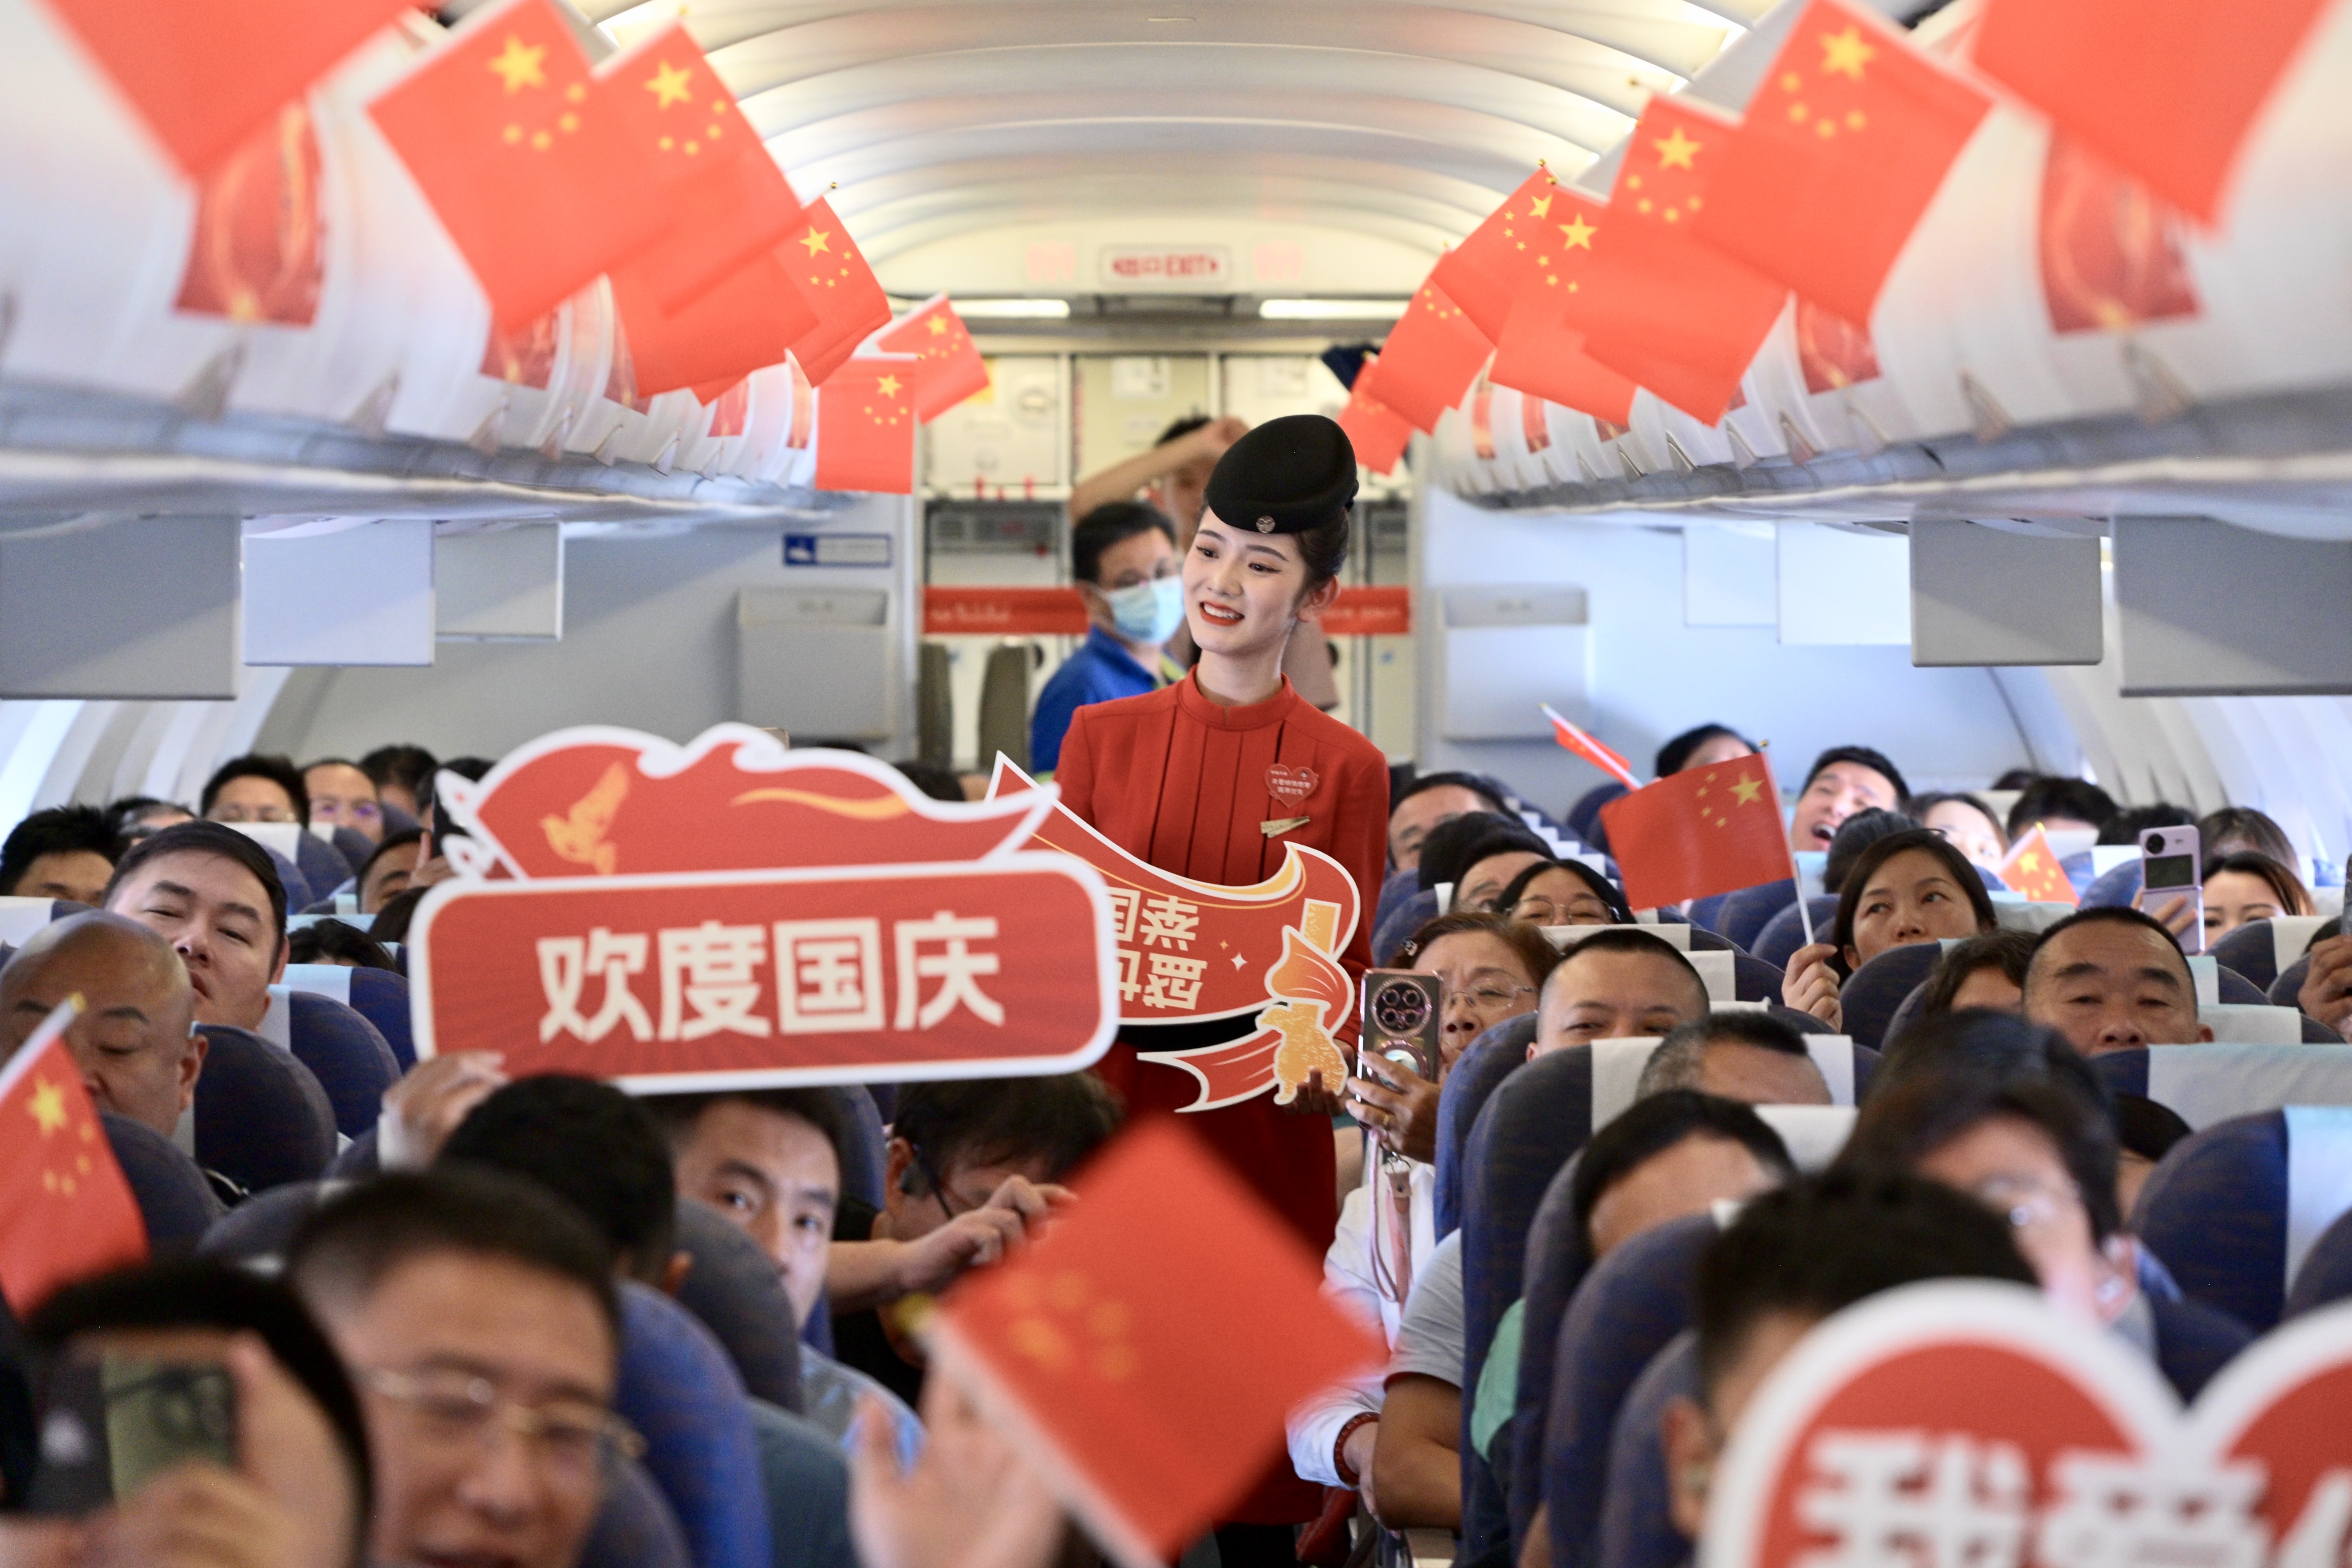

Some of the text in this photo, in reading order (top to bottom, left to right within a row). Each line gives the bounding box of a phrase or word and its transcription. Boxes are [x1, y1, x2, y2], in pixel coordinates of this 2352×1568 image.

[535, 911, 1005, 1045] 欢度国庆
[1788, 1426, 2352, 1568] 我爱
